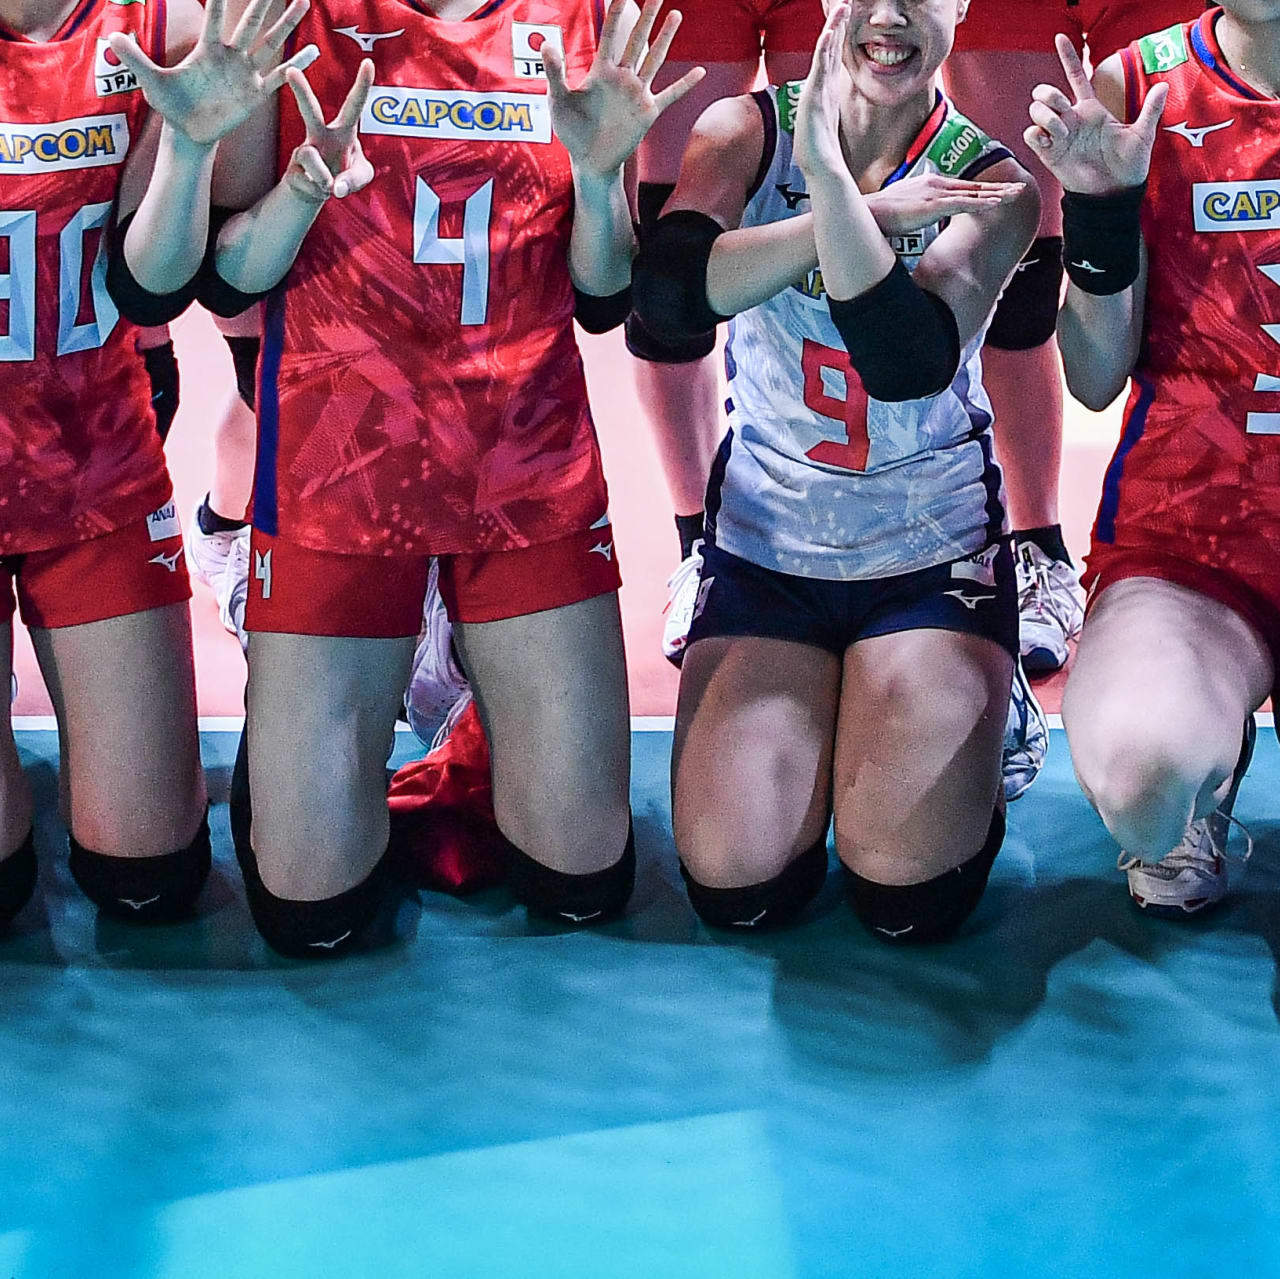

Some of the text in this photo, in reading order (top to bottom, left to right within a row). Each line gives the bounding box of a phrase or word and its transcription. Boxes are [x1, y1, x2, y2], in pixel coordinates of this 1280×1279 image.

[522, 63, 545, 76] JP
[370, 95, 534, 132] CAPCOM
[412, 174, 495, 326] 4
[895, 236, 919, 254] JP
[801, 337, 871, 472] 9
[254, 548, 272, 599] 4
